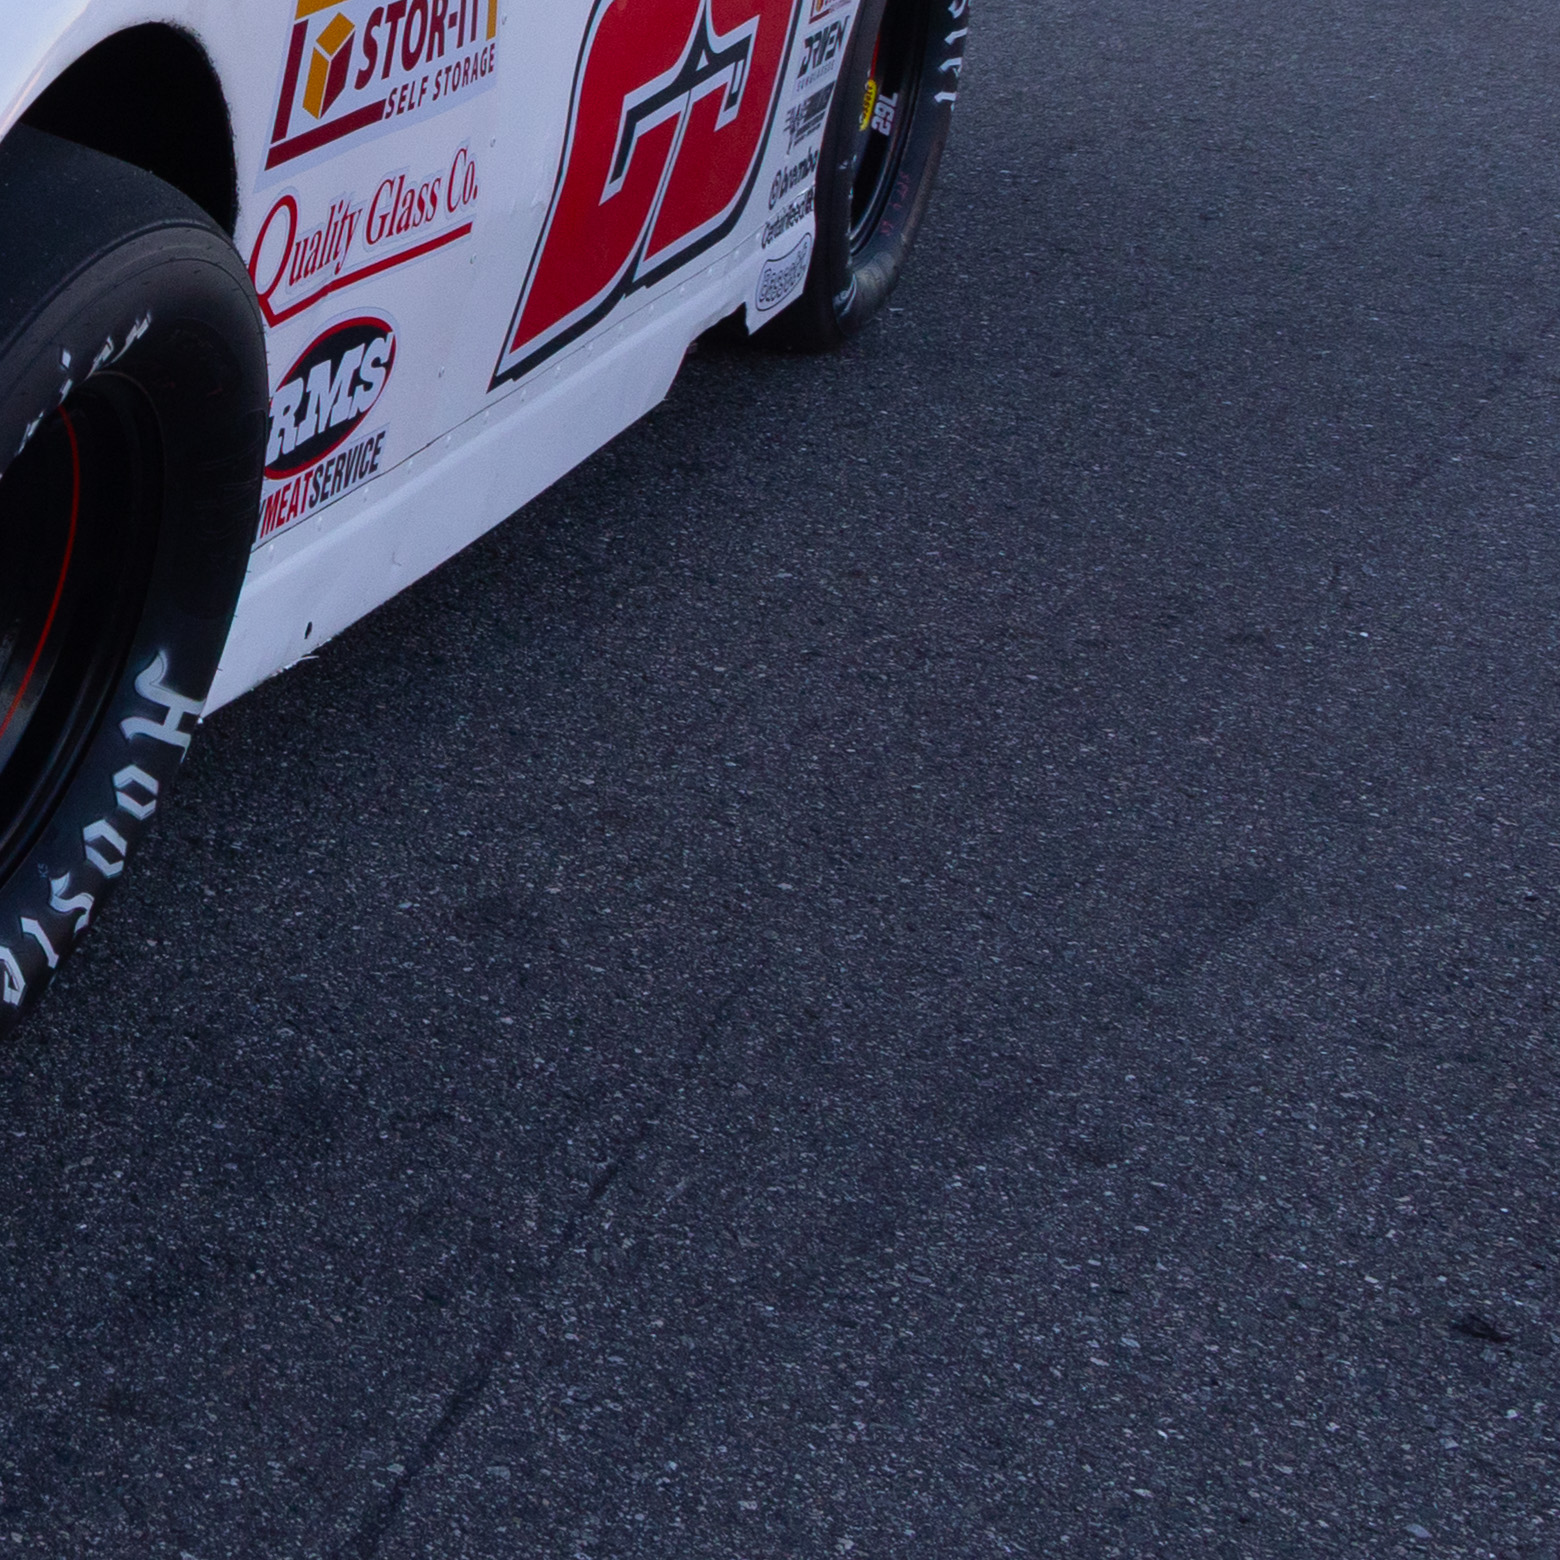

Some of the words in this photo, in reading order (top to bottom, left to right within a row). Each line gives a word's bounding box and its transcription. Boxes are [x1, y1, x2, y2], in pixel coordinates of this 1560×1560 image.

[384, 76, 429, 120] SELF
[431, 42, 496, 102] STORAGE
[871, 92, 899, 136] 29L
[247, 194, 363, 316] Quality
[365, 173, 442, 245] Glass
[446, 148, 478, 213] Co.
[265, 332, 394, 463] RMS
